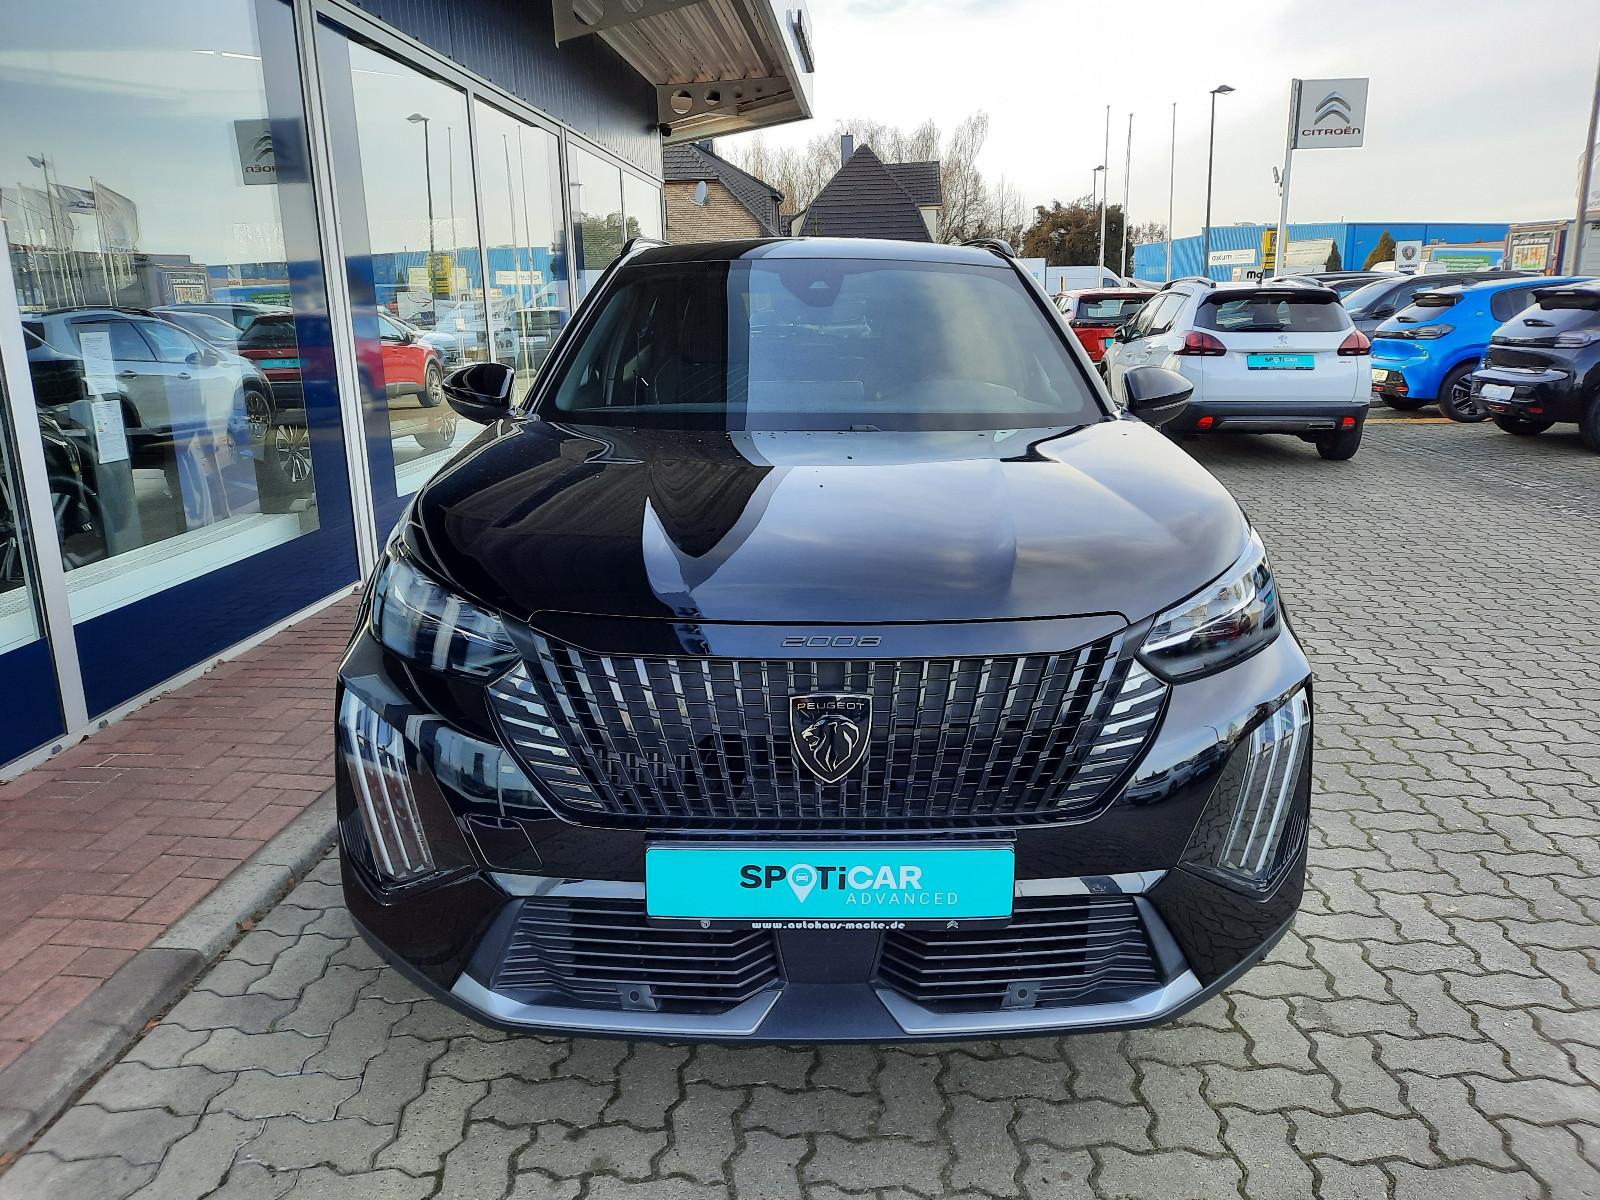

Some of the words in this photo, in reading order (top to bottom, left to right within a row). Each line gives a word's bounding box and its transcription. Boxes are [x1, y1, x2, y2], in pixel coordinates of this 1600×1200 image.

[1301, 125, 1361, 136] CITROËN
[781, 635, 882, 648] 2008
[797, 702, 865, 710] PEUGEOT
[845, 892, 958, 905] ADVANCED
[751, 920, 906, 930] www.autohaus-macke.de
